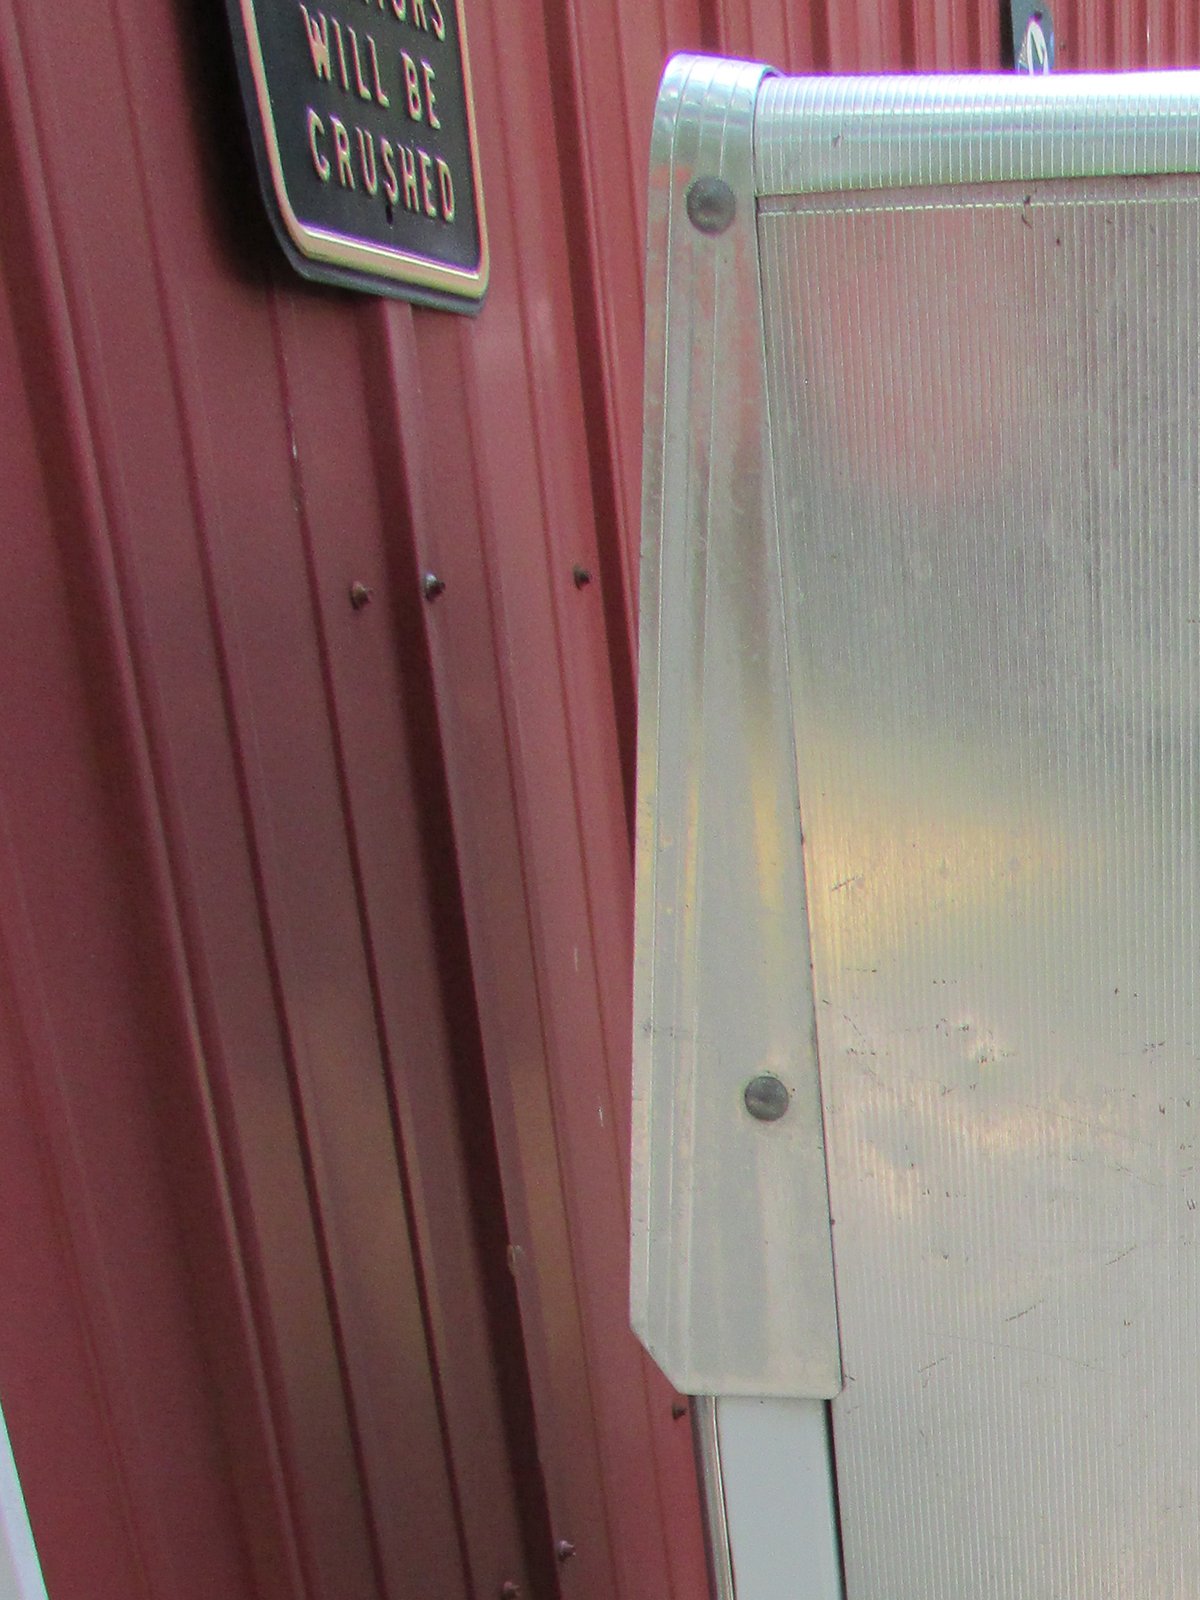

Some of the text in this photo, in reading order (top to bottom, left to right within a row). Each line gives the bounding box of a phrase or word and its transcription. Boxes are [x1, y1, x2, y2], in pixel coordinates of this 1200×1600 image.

[300, 3, 390, 108] WILL
[401, 50, 441, 130] BE
[306, 105, 456, 223] CRUSHED
